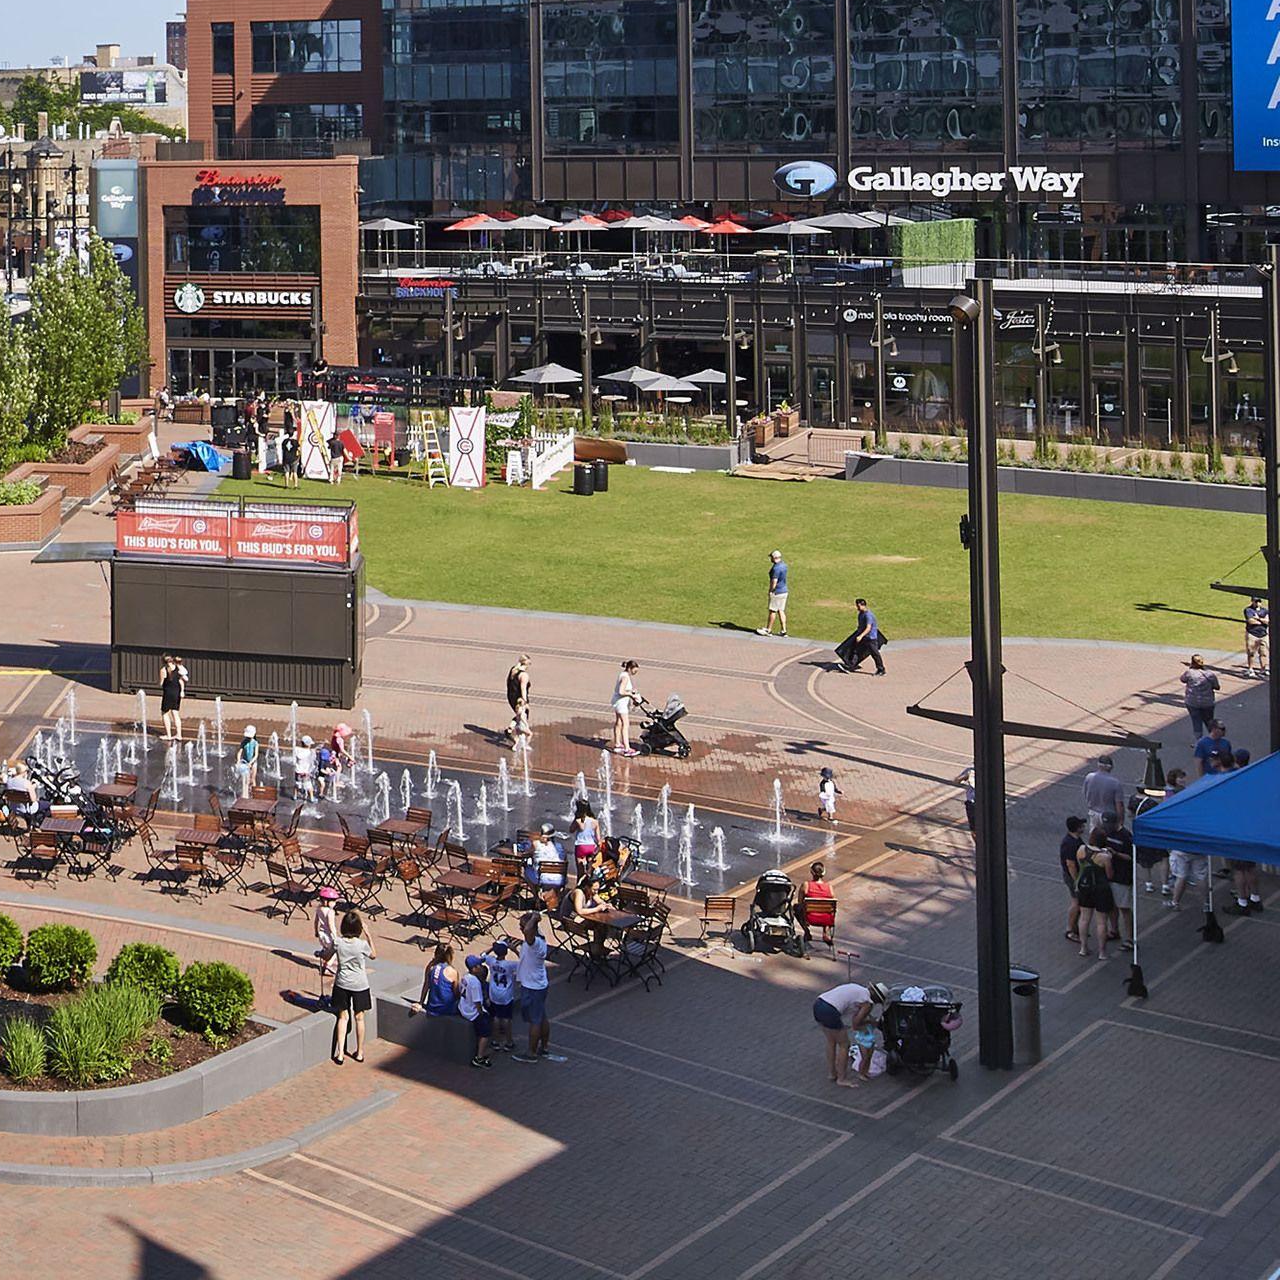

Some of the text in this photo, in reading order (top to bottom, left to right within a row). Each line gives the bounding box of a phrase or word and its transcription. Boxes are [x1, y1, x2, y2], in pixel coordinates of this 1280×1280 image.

[1263, 136, 1280, 148] Ins
[847, 166, 1004, 197] Gallagher
[1009, 166, 1084, 197] Way
[101, 194, 134, 203] Gallagher
[110, 201, 126, 210] Way
[213, 291, 312, 305] STARBUCKS
[858, 311, 953, 323] motola trophy room
[123, 535, 223, 552] THIS BUD'S FOR YOU.
[236, 541, 340, 557] THIS BUD'S FOR YOU.
[493, 973, 508, 988] 44
